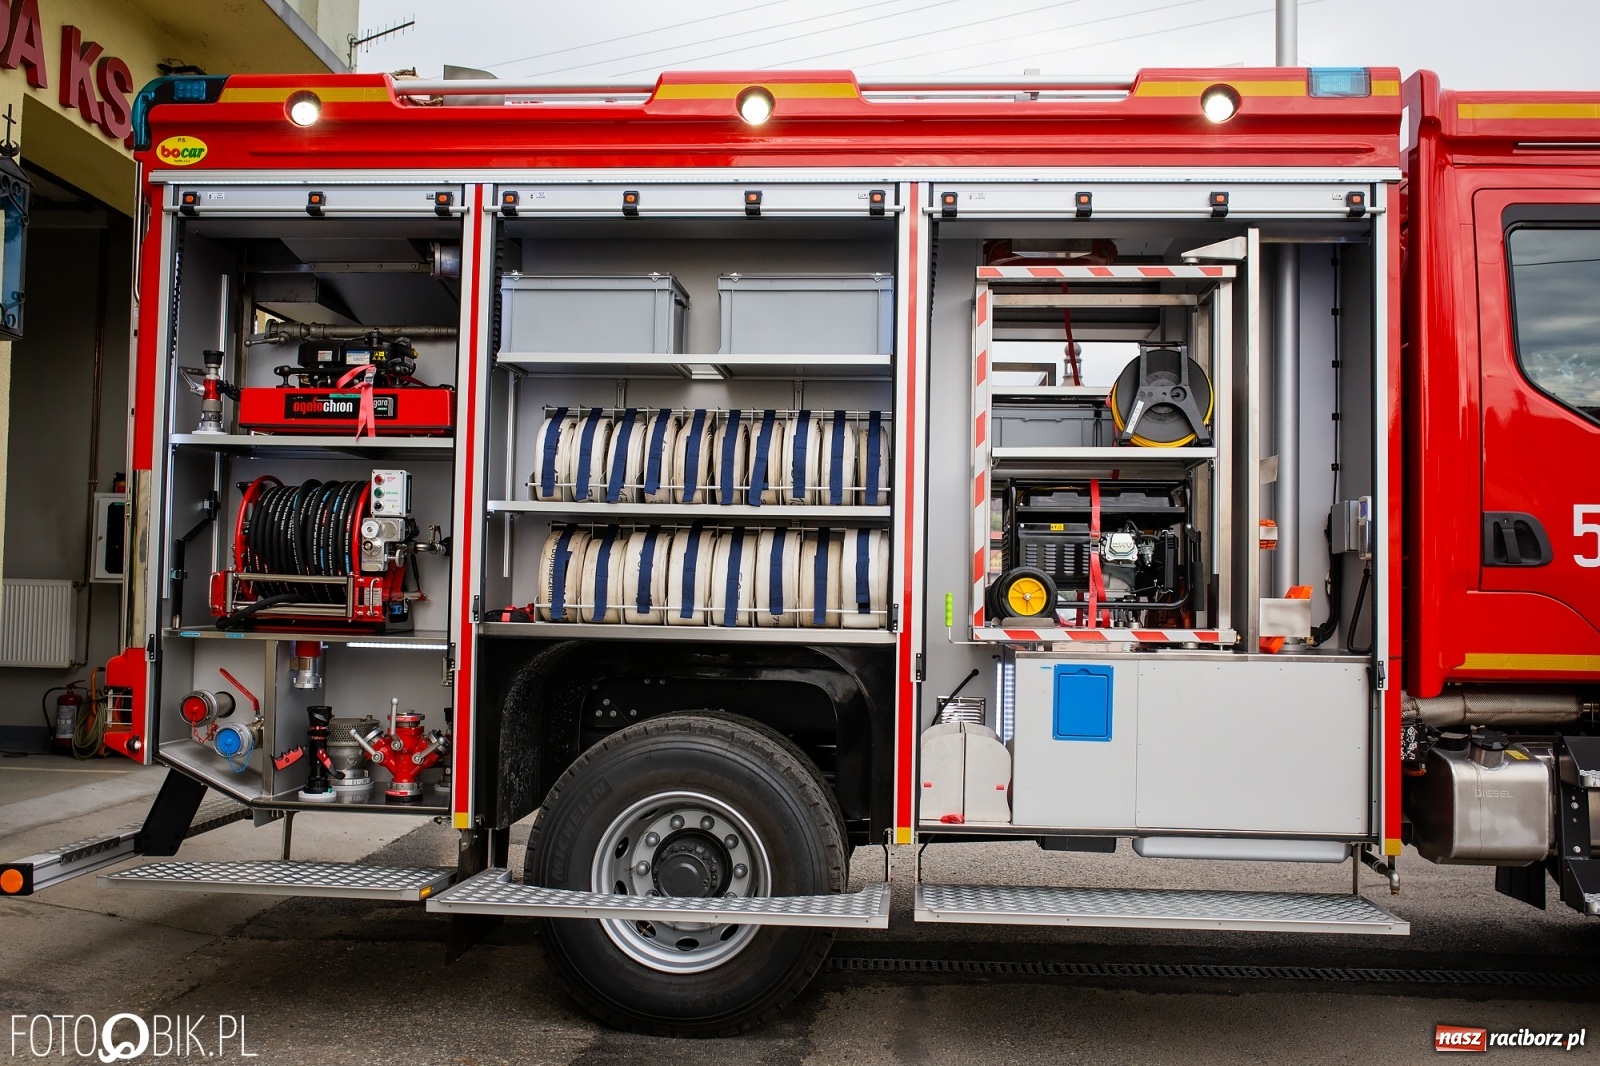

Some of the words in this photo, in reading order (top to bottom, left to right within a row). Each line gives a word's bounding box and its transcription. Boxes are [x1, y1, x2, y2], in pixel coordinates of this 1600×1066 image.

[160, 145, 205, 158] bocar
[293, 397, 353, 414] ogniochron
[1474, 789, 1514, 798] DIESEL
[551, 781, 607, 882] MICHELIN
